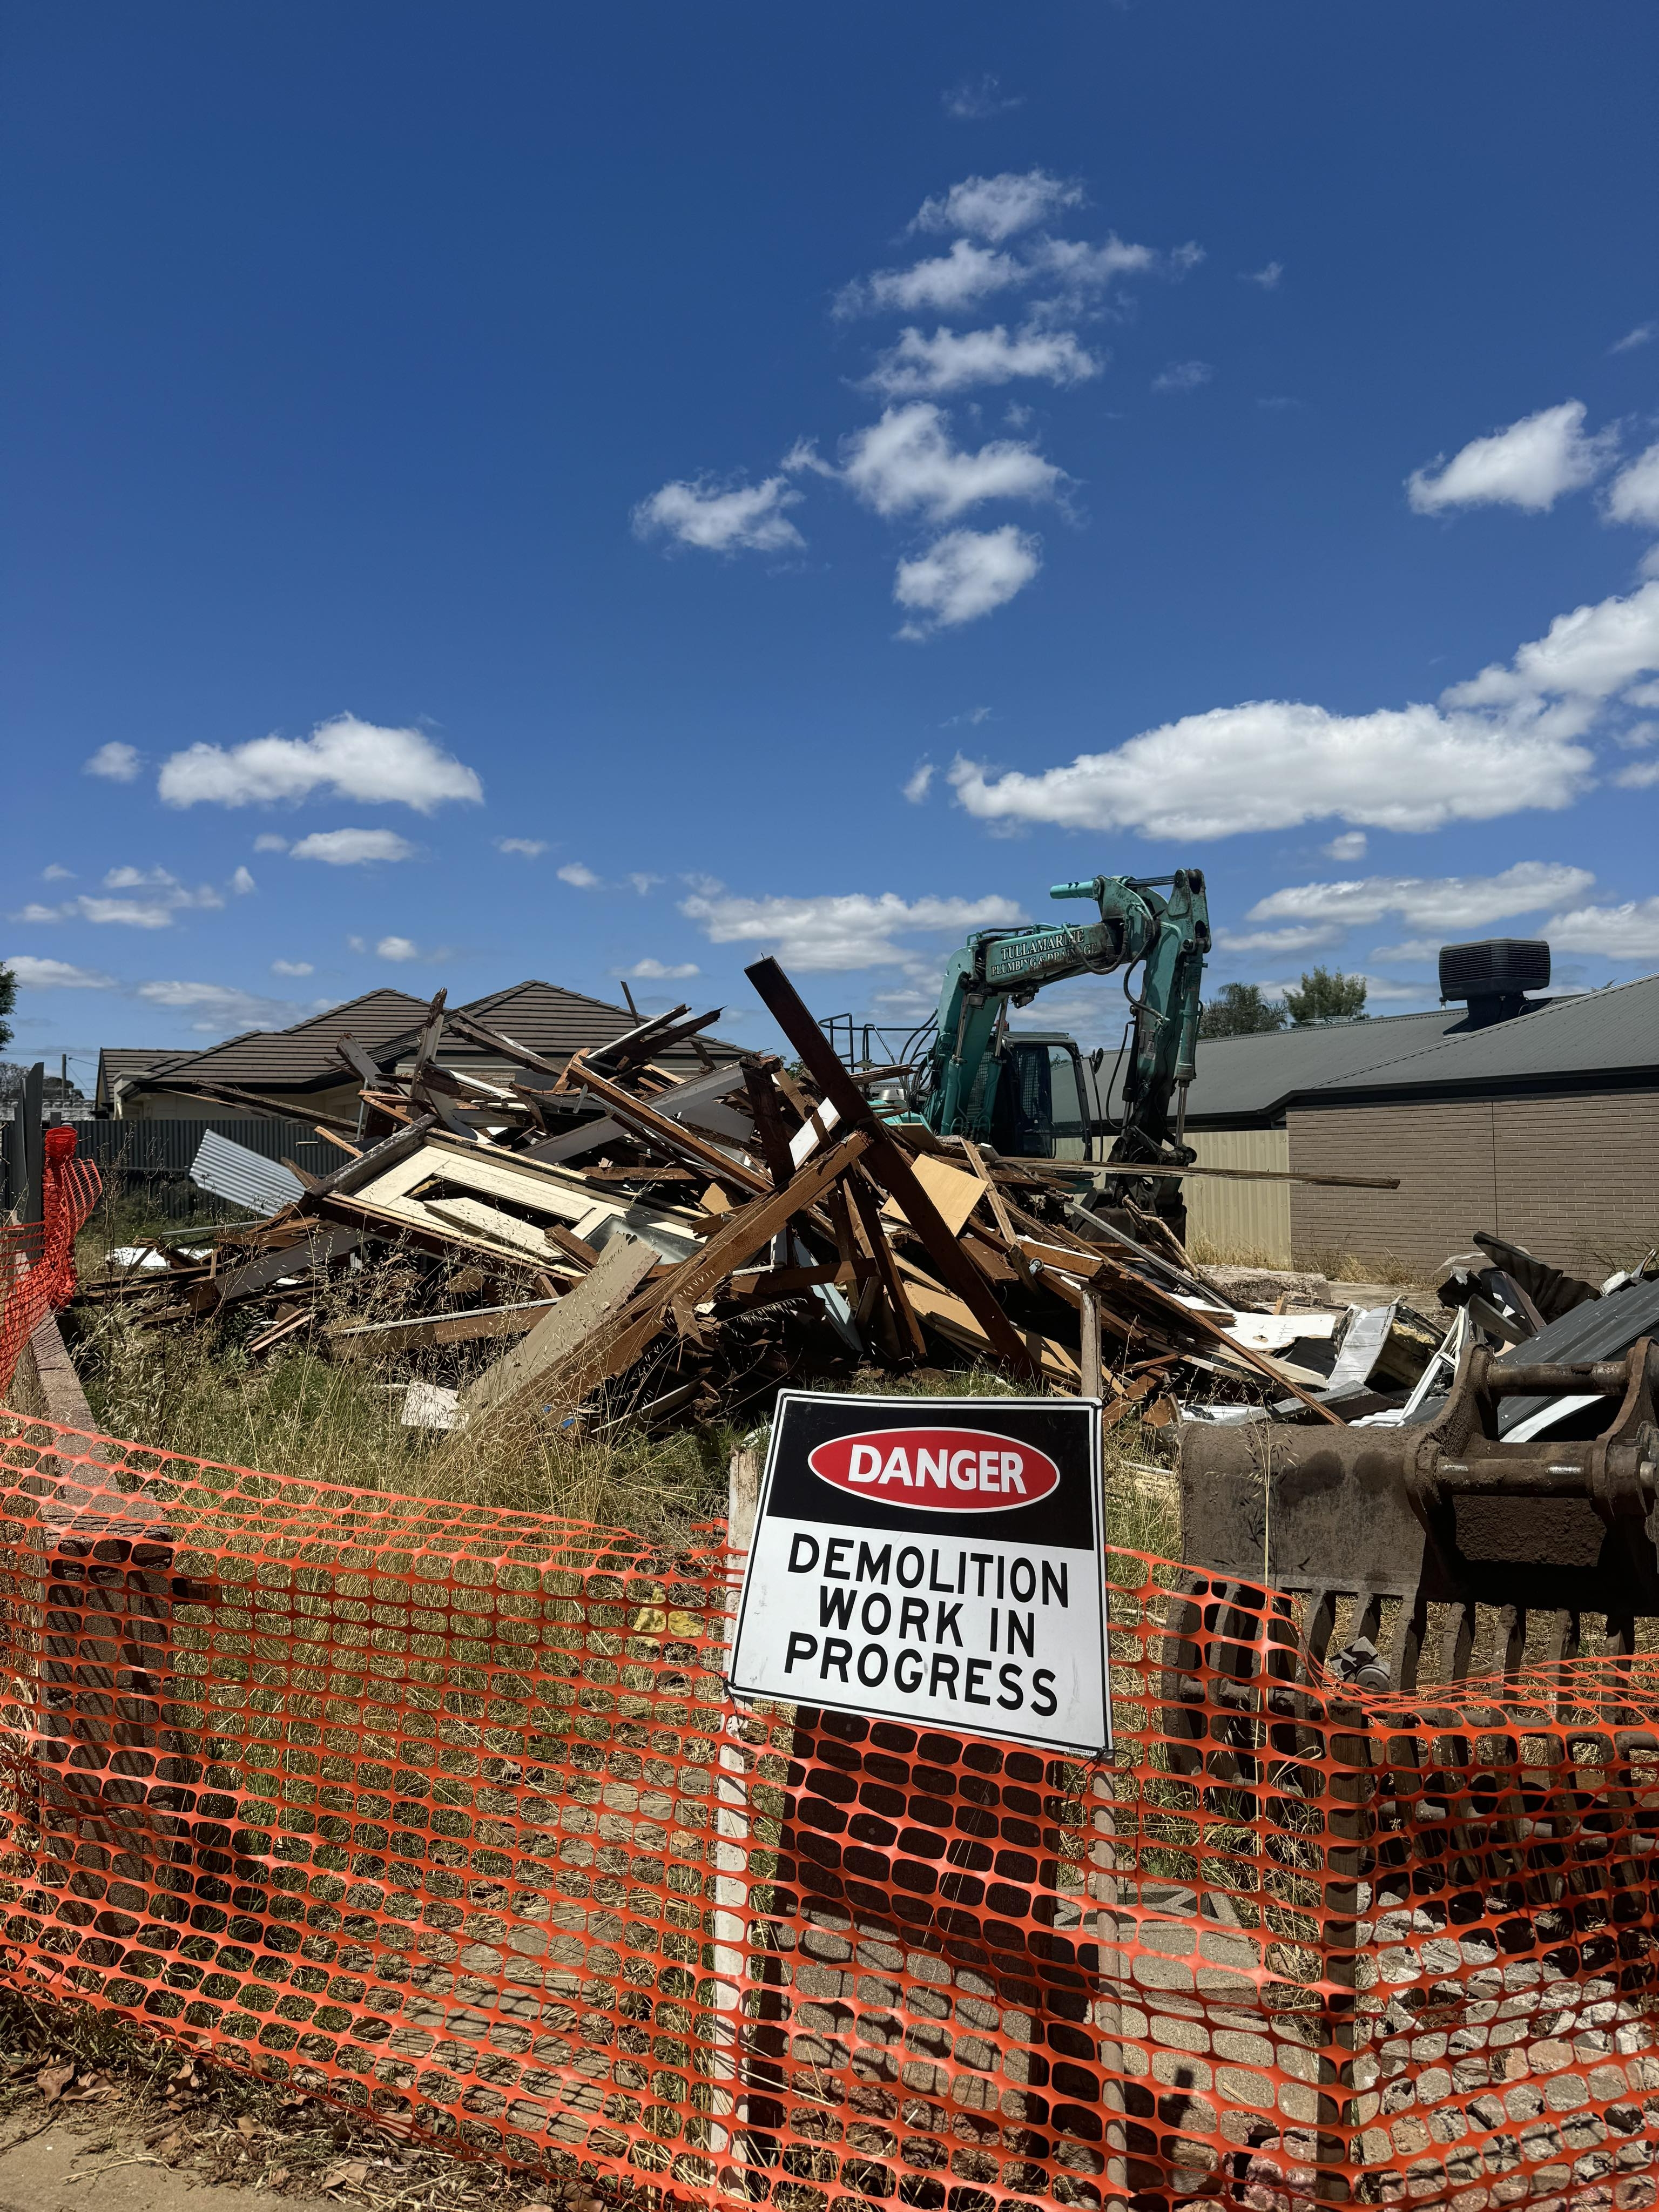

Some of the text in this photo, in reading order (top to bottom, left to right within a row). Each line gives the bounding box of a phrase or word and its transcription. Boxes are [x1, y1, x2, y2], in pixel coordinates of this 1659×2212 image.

[1001, 930, 1084, 961] TULLAMARINE
[1047, 943, 1097, 962] DRAINGE
[848, 1444, 1027, 1494] DANGER
[787, 1533, 1068, 1608] DEMOLITION
[819, 1585, 1035, 1658] WORK IN
[785, 1631, 1058, 1717] PROGRESS
